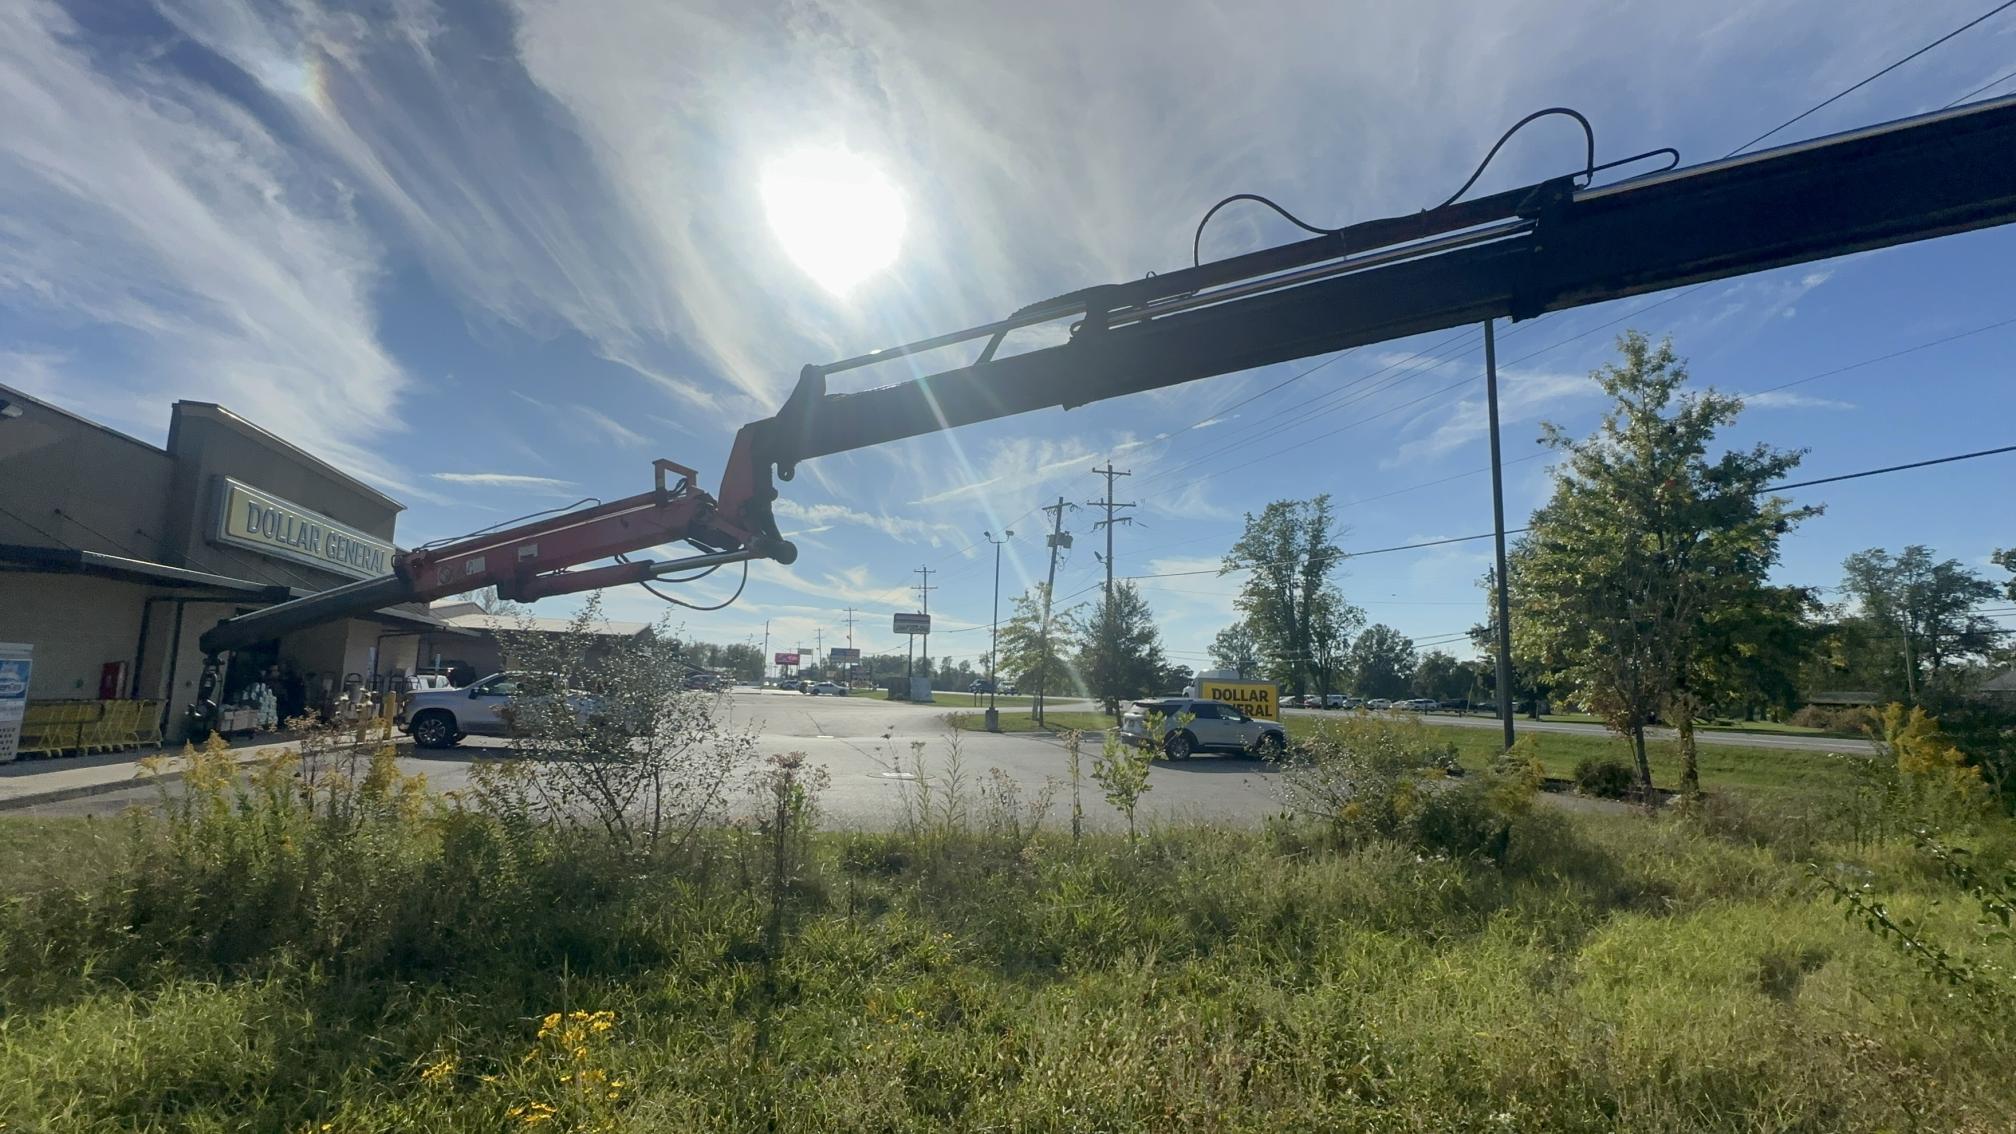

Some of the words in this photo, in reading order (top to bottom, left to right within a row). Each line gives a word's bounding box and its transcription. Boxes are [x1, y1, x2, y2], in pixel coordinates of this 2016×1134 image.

[247, 501, 320, 553] DOLLAR
[326, 531, 386, 574] GENERAL
[1211, 688, 1269, 702] DOLLAR
[1232, 703, 1273, 717] ERAL
